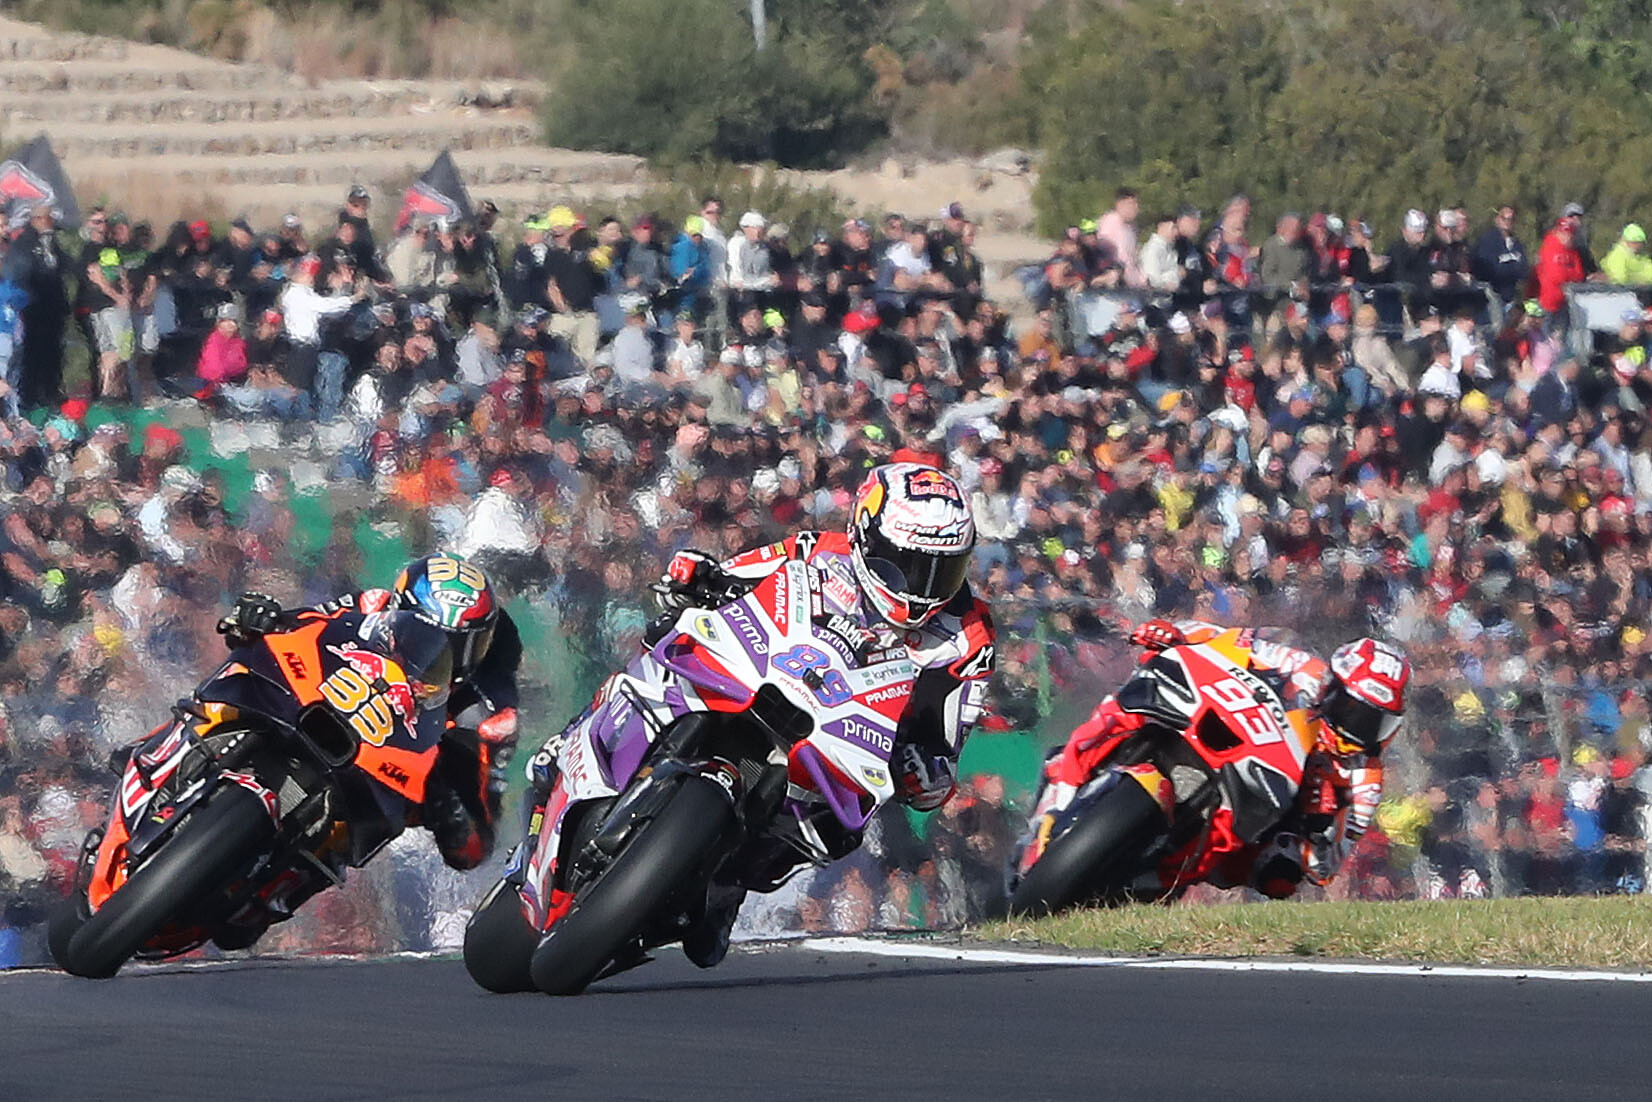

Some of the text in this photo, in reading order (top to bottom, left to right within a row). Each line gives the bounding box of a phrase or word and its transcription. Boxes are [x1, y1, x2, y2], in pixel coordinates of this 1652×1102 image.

[427, 557, 486, 590] 33
[774, 571, 787, 625] PRAMAC
[723, 602, 769, 655] prima
[817, 629, 855, 664] prima
[283, 650, 306, 680] KTM
[770, 644, 854, 708] 89
[318, 666, 394, 748] 33
[778, 676, 821, 715] PRAMAC
[864, 684, 911, 706] PRAMAC
[1199, 677, 1285, 747] 93
[841, 718, 894, 753] prima
[378, 762, 410, 788] KTM
